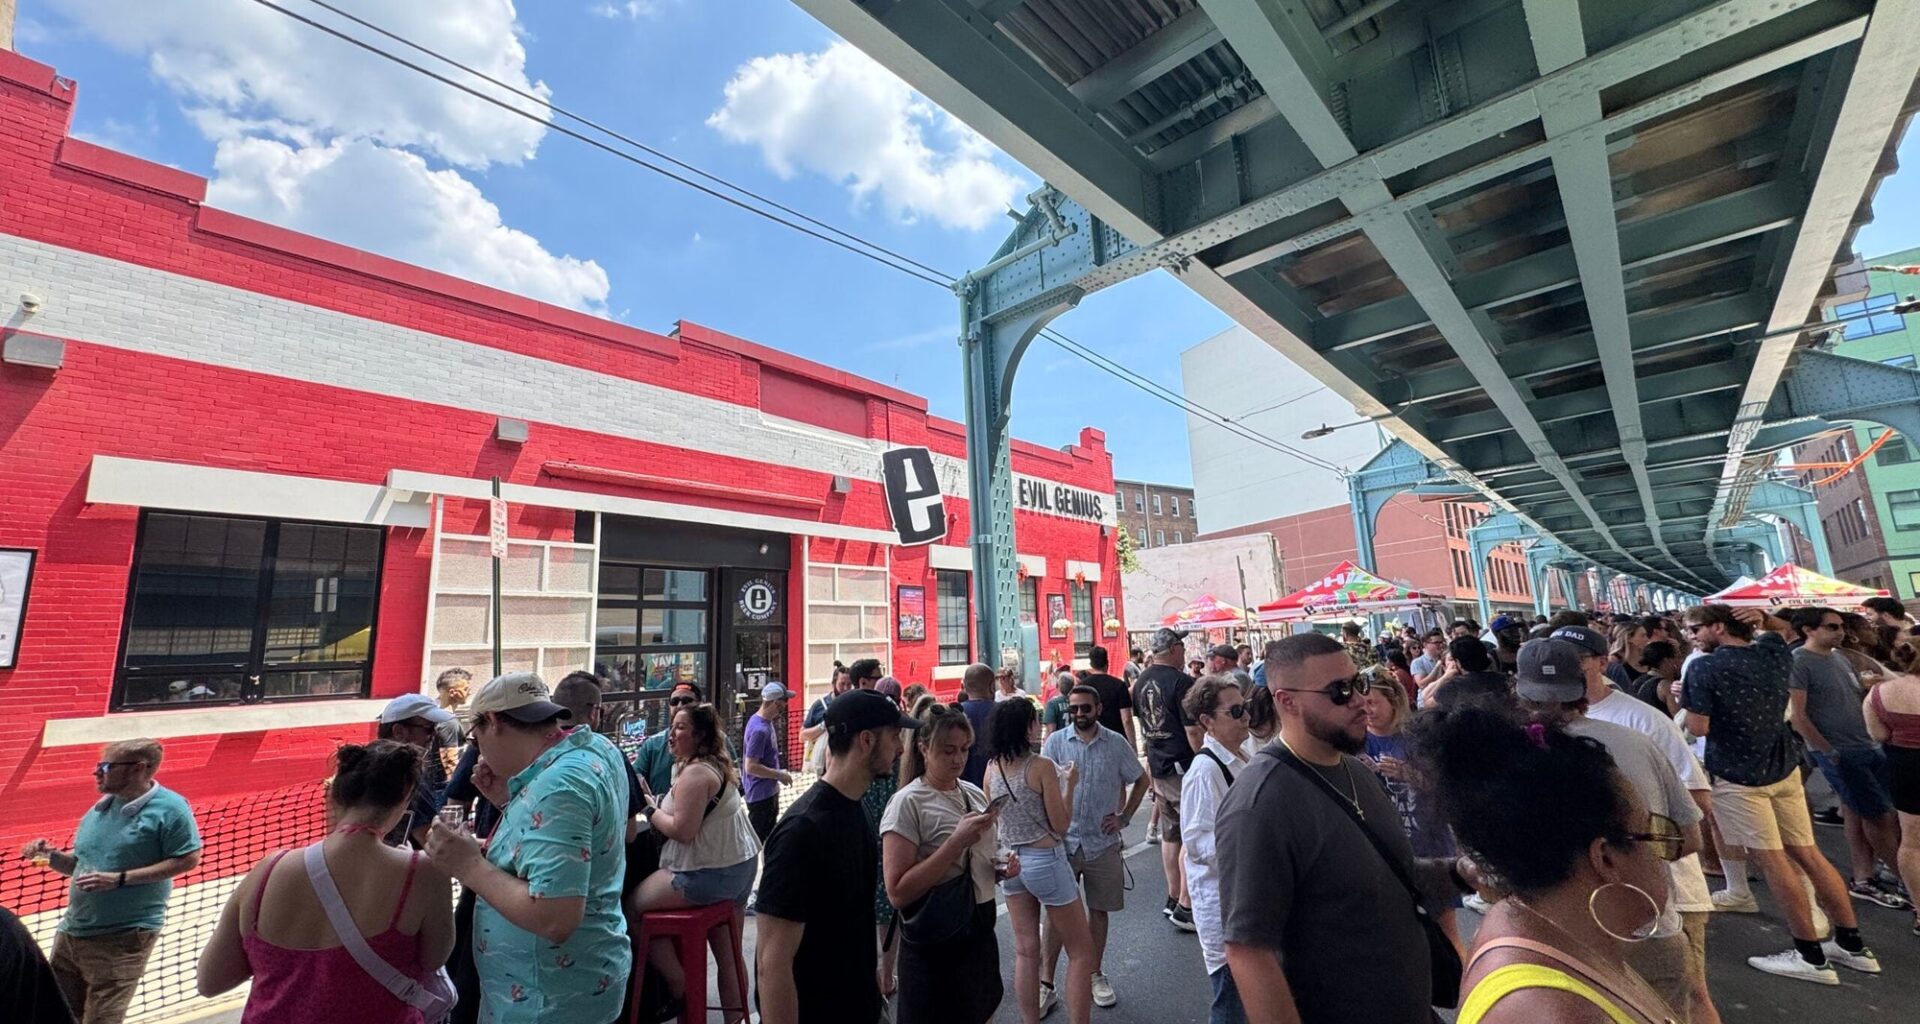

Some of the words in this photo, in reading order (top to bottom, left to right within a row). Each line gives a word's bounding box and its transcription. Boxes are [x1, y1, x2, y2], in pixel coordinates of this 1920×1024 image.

[1018, 477, 1052, 510] EVIL
[1054, 486, 1103, 520] GENIUS
[741, 580, 753, 592] EVIL
[754, 578, 776, 594] GENIUS
[739, 599, 751, 617] BEER
[751, 601, 777, 620] COMPANY
[1565, 630, 1585, 641] DAD
